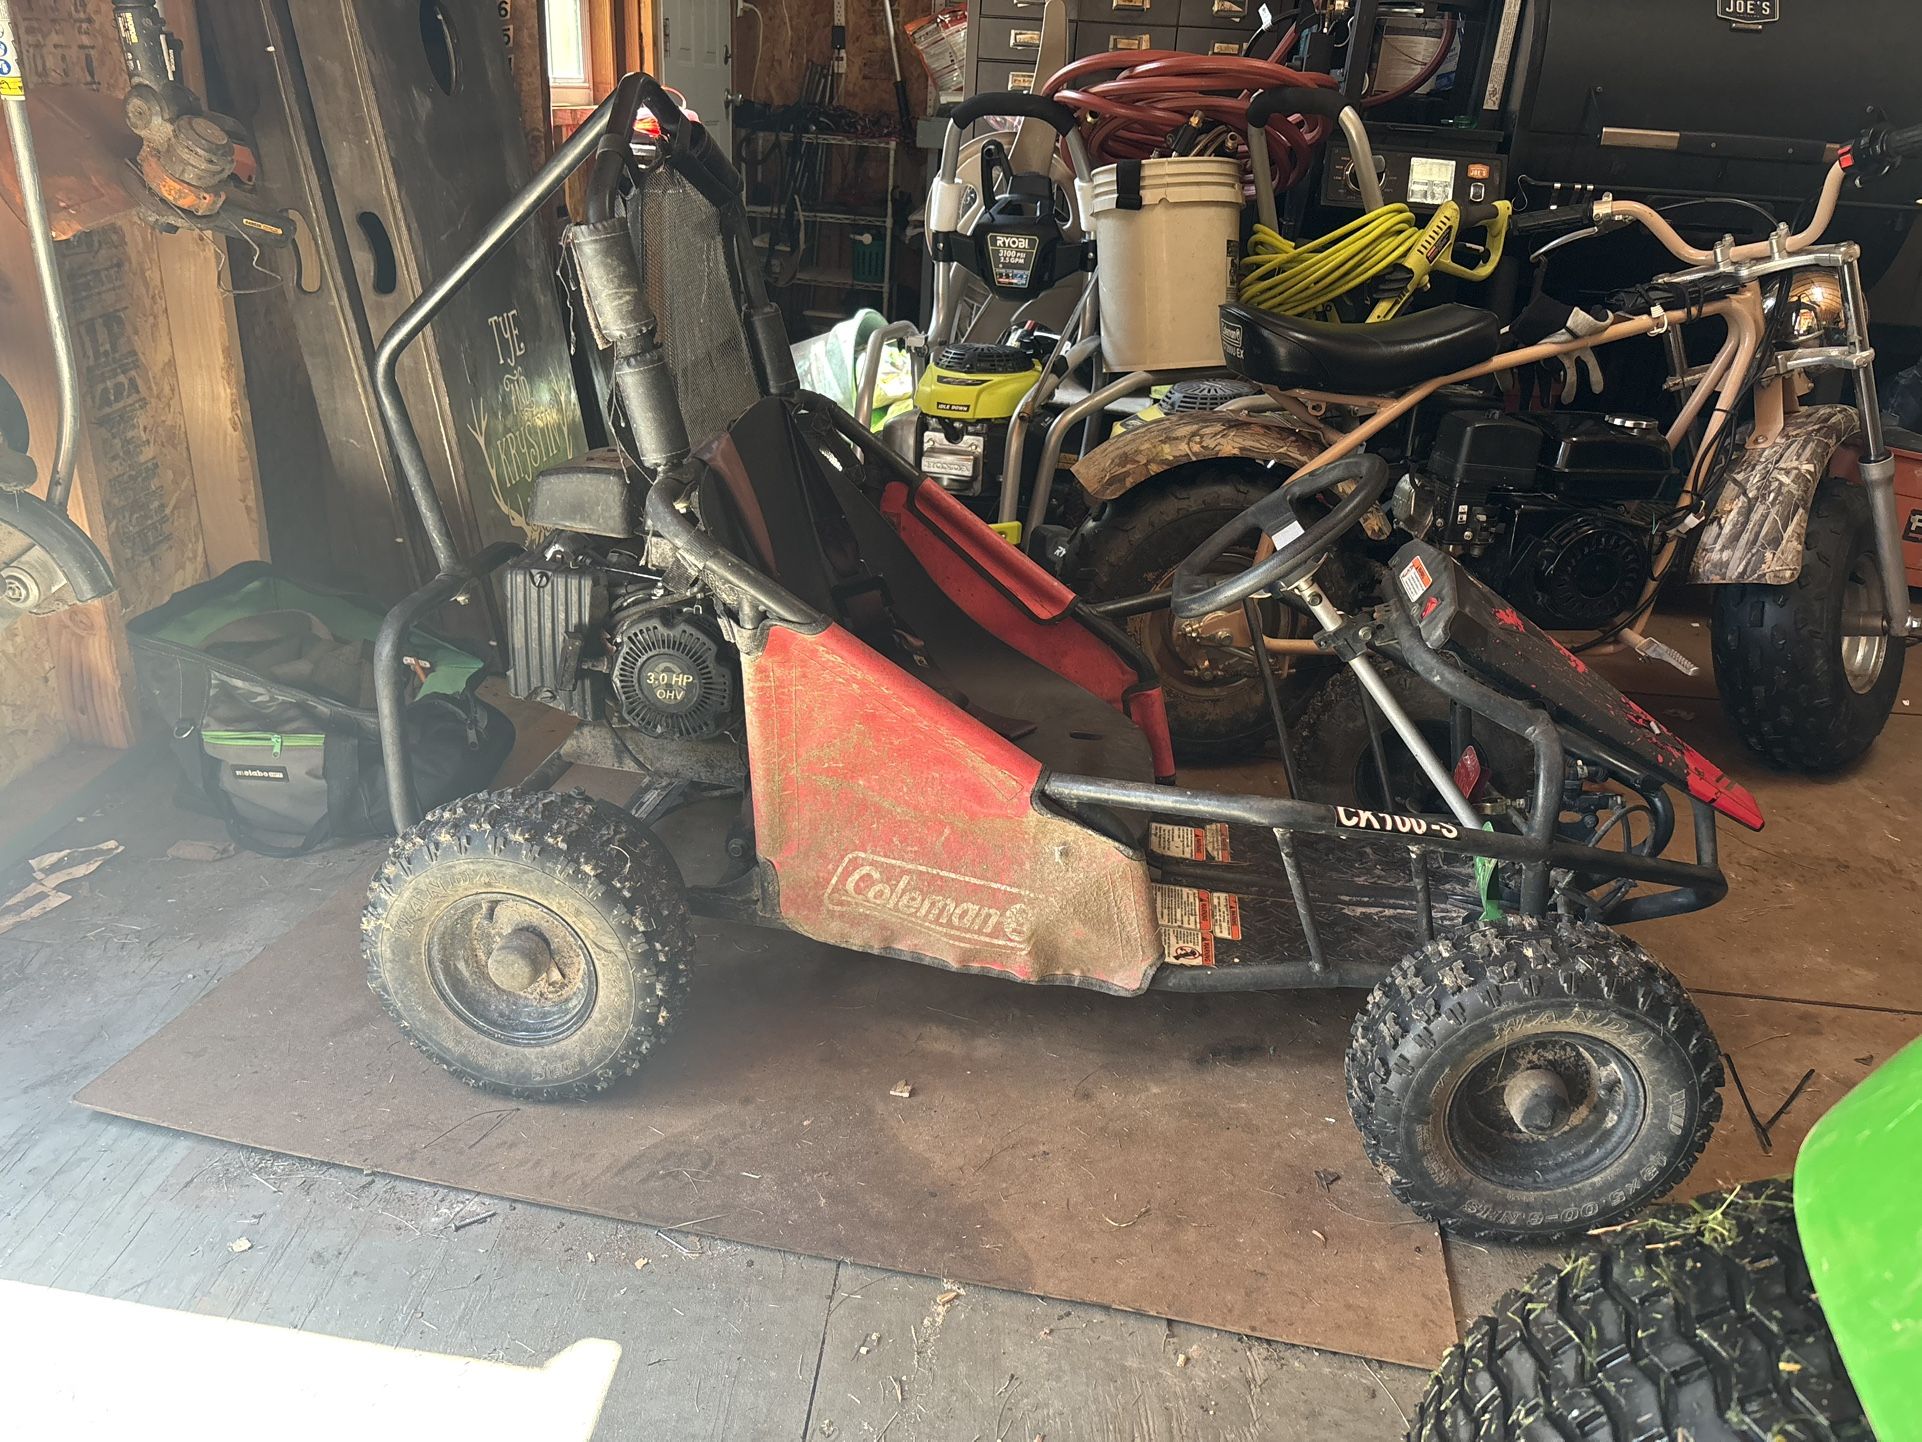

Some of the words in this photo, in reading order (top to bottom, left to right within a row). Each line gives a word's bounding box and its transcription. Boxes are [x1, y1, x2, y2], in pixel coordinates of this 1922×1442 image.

[1725, 0, 1770, 15] JOE'S
[996, 236, 1030, 249] RYOBI
[999, 249, 1017, 259] 3100
[488, 309, 526, 367] TYE
[646, 672, 668, 685] 3.0
[672, 674, 693, 686] HP
[656, 689, 685, 700] OHV
[845, 865, 1001, 934] Coleman
